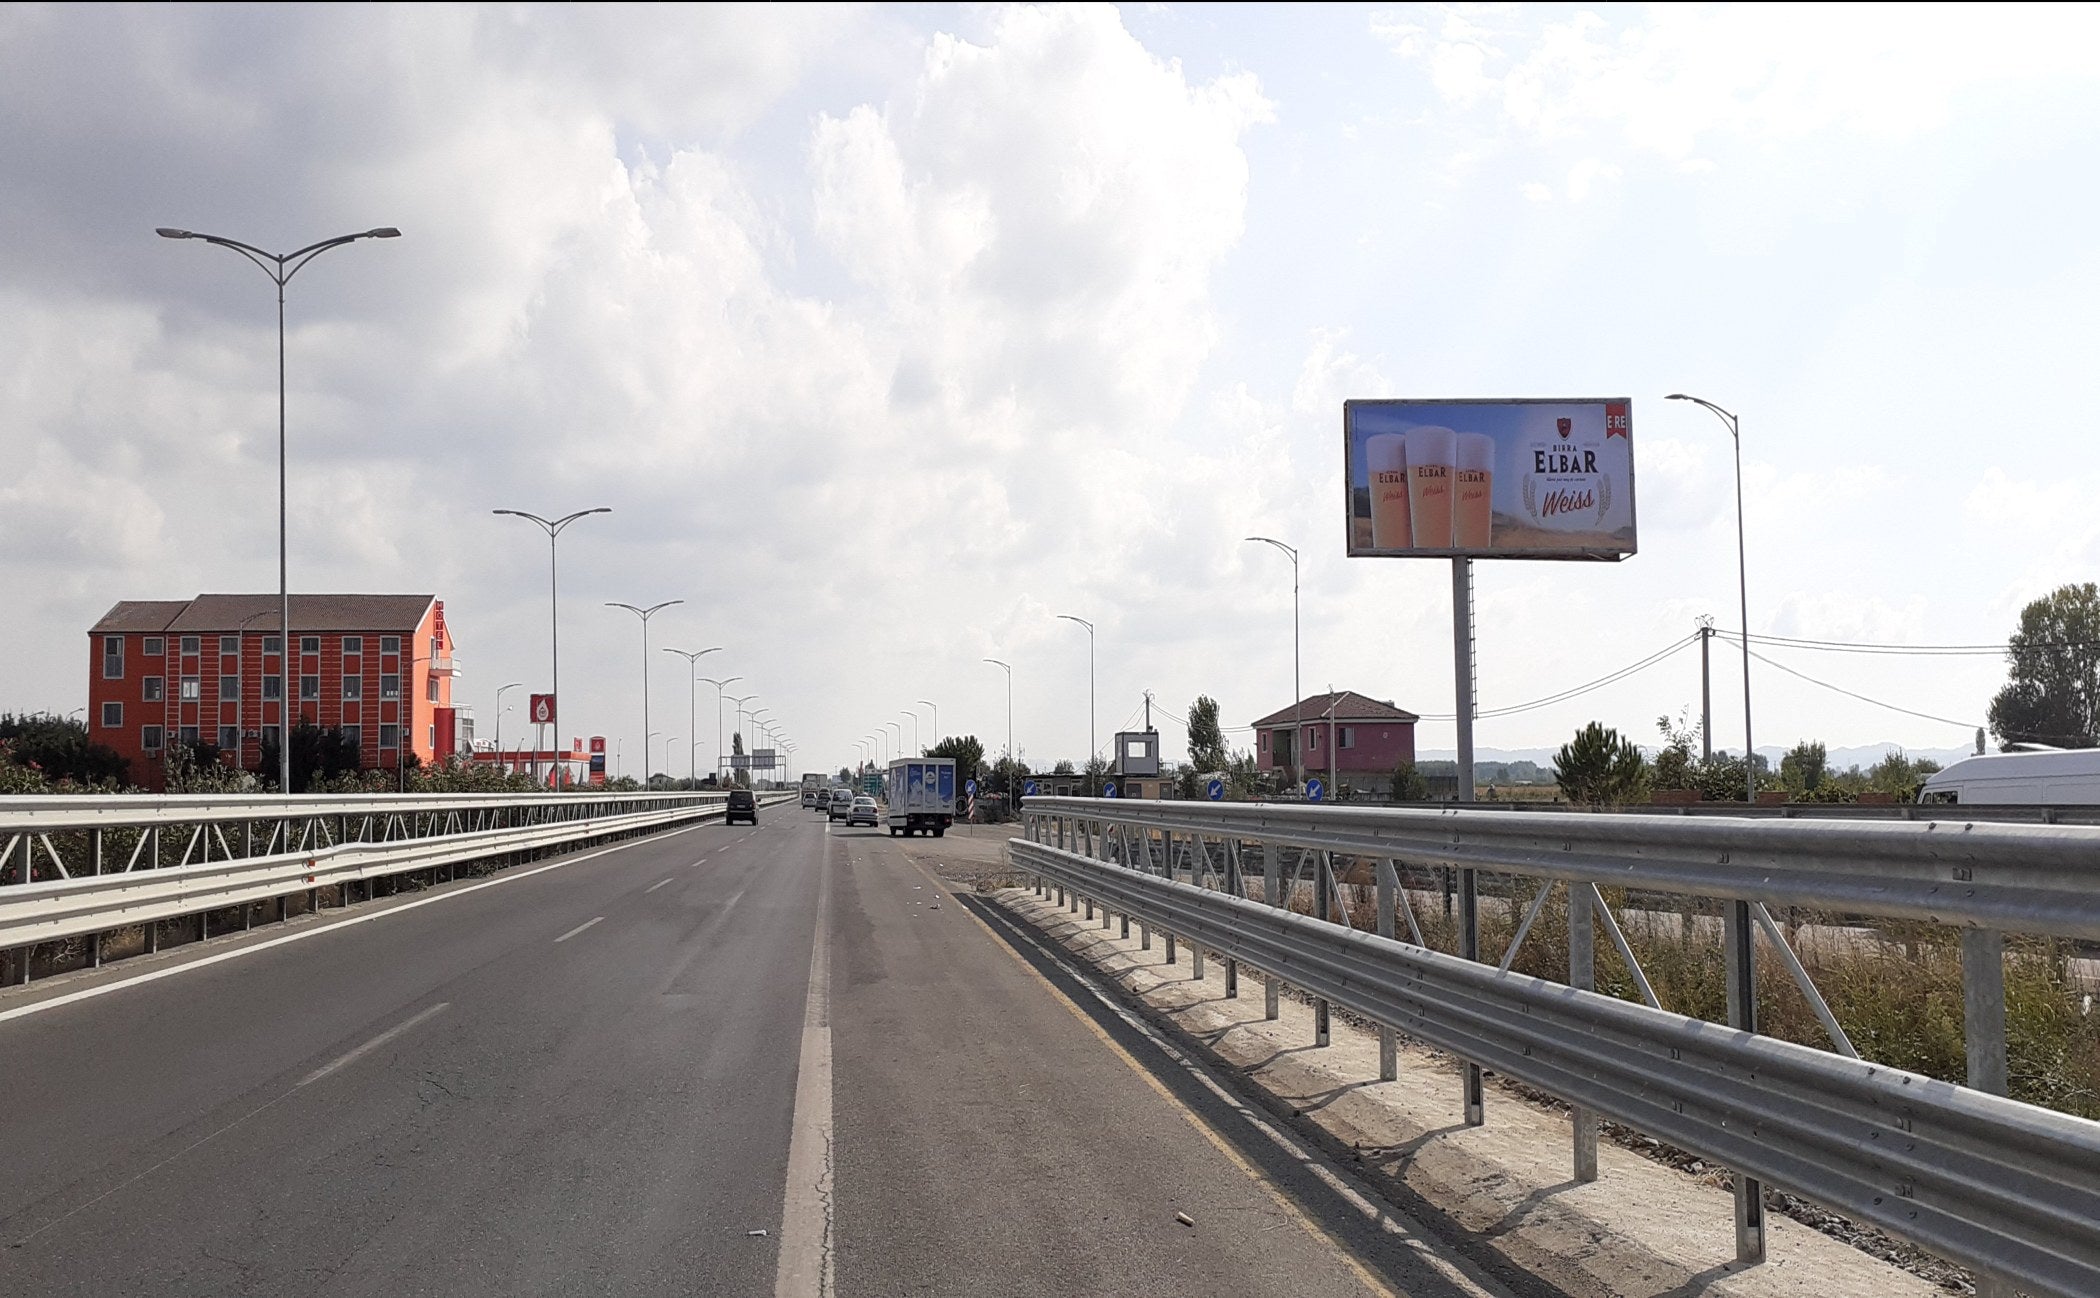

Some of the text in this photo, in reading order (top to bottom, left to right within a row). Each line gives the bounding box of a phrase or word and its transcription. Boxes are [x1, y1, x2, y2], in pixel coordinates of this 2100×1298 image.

[1615, 415, 1626, 428] RE
[1552, 444, 1577, 452] BIRRA
[1534, 450, 1599, 473] ELBAR
[1379, 472, 1405, 483] ELBAR
[1418, 467, 1446, 478] ELBAR
[1458, 472, 1485, 483] ELBAR
[1542, 487, 1595, 518] Weiss
